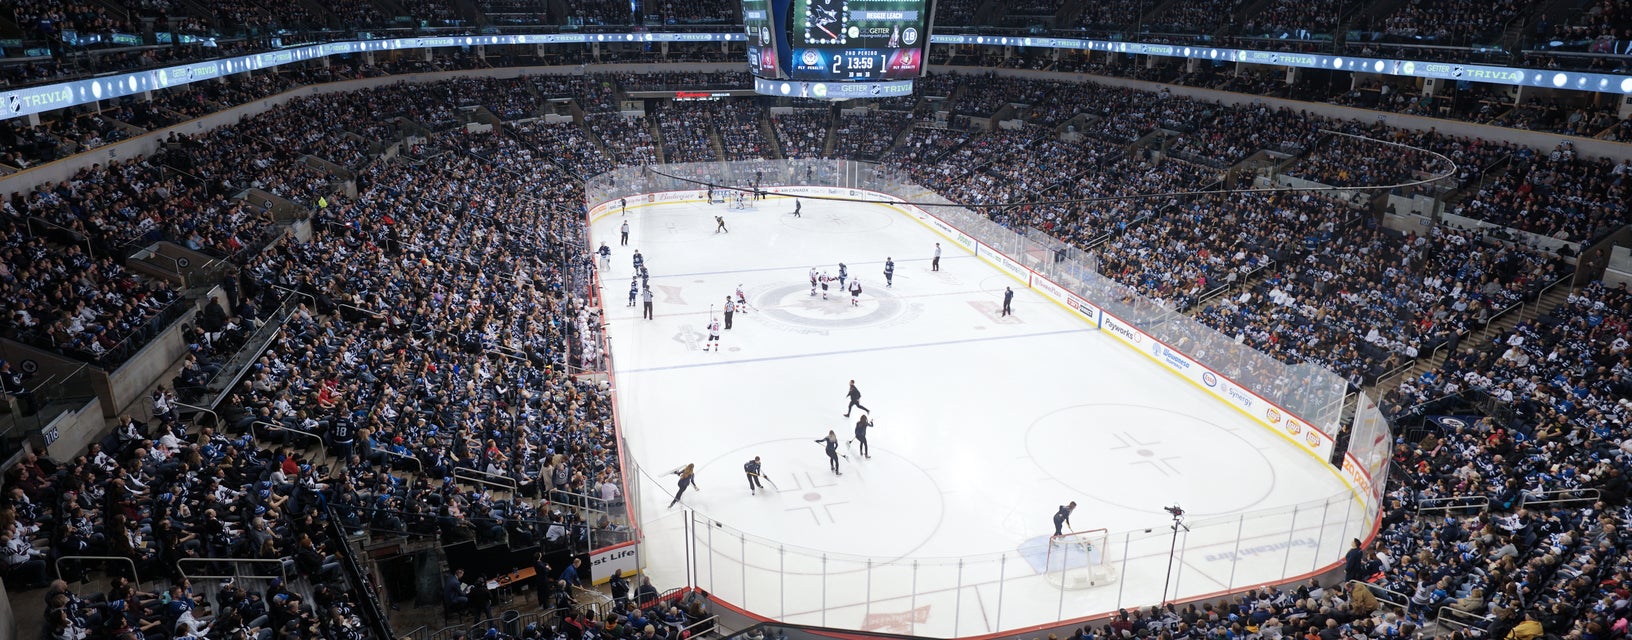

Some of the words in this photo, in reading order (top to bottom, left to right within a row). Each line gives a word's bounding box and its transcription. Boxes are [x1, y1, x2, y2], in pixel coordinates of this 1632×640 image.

[905, 32, 915, 41] 18
[832, 54, 842, 73] 2
[847, 57, 873, 69] 13:59
[880, 54, 887, 73] 1
[1280, 56, 1312, 64] TRIVIA
[193, 65, 216, 77] TRIVIA
[1426, 64, 1450, 72] GETTER
[1466, 69, 1518, 80] TRIVIA
[884, 83, 913, 93] TRIVIA
[23, 91, 68, 107] TRIVIA
[1105, 318, 1134, 340] Payworks
[1228, 387, 1252, 407] Synergy
[46, 428, 59, 445] 116
[336, 426, 347, 437] 18
[611, 549, 635, 561] Life
